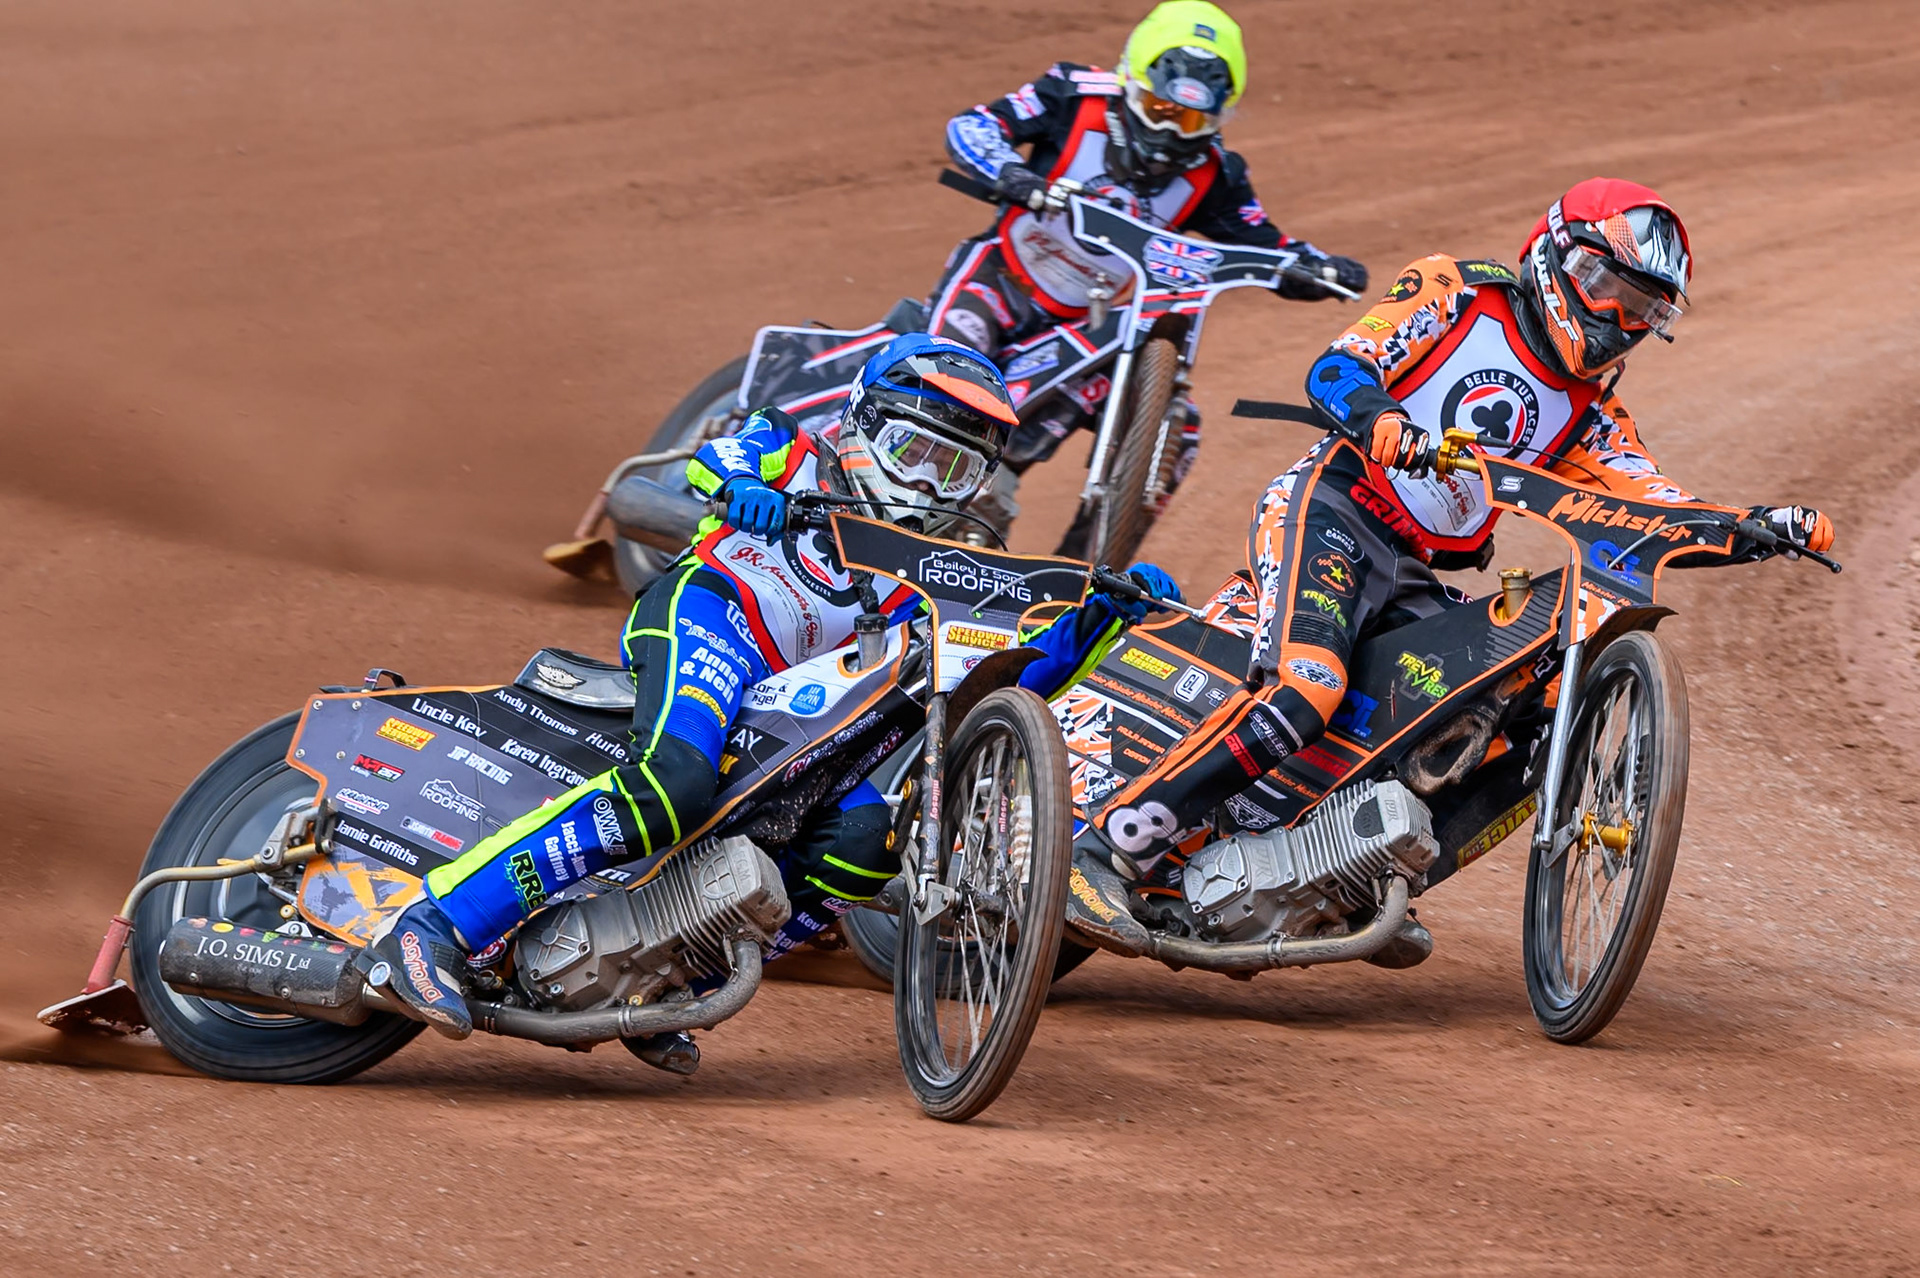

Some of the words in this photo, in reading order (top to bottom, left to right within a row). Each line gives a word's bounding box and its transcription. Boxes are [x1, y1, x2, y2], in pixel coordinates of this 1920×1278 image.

[1464, 371, 1508, 389] BELLE
[1512, 378, 1534, 405] VUE
[1522, 408, 1537, 443] ACES
[1547, 491, 1692, 543] Mickster
[790, 559, 832, 597] MANCHESTER
[926, 569, 1032, 602] ROOFING
[934, 560, 977, 575] Bailey
[993, 571, 1026, 586] Sons
[947, 633, 996, 649] SERVICE
[948, 625, 1012, 643] SPEEDWAY
[679, 661, 696, 676] &
[699, 667, 735, 705] Neil
[691, 647, 739, 689] Anne
[1397, 652, 1442, 683] TREVS
[1404, 669, 1449, 699] TYRES
[384, 716, 437, 740] SPEEDWAY
[411, 698, 454, 725] Uncle
[455, 714, 488, 738] Kev
[493, 689, 525, 713] Andy
[529, 704, 579, 737] Thomas
[380, 725, 418, 745] SERVICE
[1253, 712, 1288, 758] SPILLER
[465, 752, 513, 786] RACING
[500, 738, 540, 764] Karen
[539, 753, 588, 787] Ingram
[422, 788, 481, 822] ROOFING
[334, 820, 369, 843] Jamie
[369, 834, 420, 866] Griffiths
[544, 835, 570, 883] Gaffney
[193, 935, 229, 959] J.O.
[233, 943, 285, 968] SIMS
[285, 951, 312, 973] Ltd
[401, 930, 446, 1004] daytona
